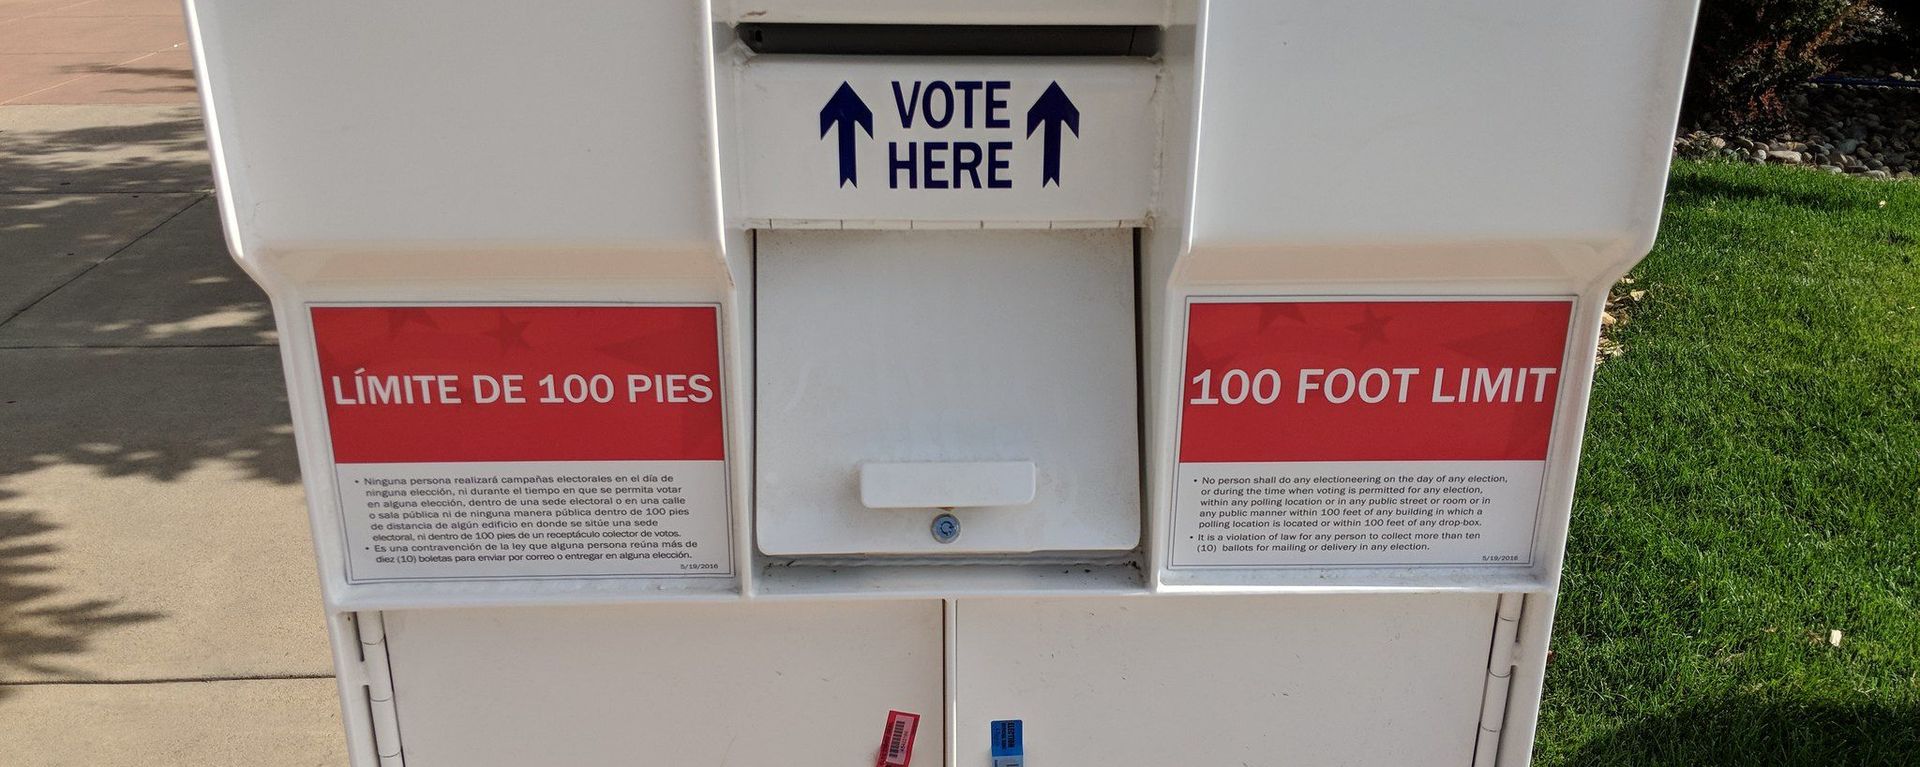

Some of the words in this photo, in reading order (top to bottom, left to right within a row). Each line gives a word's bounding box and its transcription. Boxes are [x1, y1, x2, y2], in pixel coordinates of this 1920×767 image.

[891, 80, 1011, 129] VOTE
[888, 141, 1013, 189] HERE
[331, 367, 462, 405] LÍMITE
[472, 374, 526, 404] DE
[538, 373, 614, 404] 100
[627, 373, 714, 404] PIES
[1190, 368, 1281, 405] 100
[1297, 367, 1420, 404] FOOT
[1431, 367, 1557, 403] LIMIT
[363, 477, 407, 487] Ninguna
[453, 476, 498, 484] realizará
[500, 475, 554, 484] campañas
[642, 474, 658, 482] día
[660, 474, 673, 482] de
[1202, 476, 1215, 484] No
[1217, 477, 1250, 485] person
[1293, 477, 1311, 485] any
[1312, 475, 1381, 485] electioneering
[1416, 475, 1433, 484] day
[1447, 476, 1465, 484] any
[1467, 475, 1507, 483] election,
[365, 489, 407, 498] ninguna
[409, 487, 455, 496] elección,
[470, 487, 510, 495] durante
[524, 487, 560, 495] tiempo
[578, 487, 597, 495] que
[614, 485, 653, 494] permita
[1213, 487, 1244, 496] during
[1246, 487, 1261, 495] the
[1316, 486, 1345, 495] voting
[1358, 486, 1405, 495] permitted
[1407, 485, 1421, 493] for
[1423, 487, 1440, 495] any
[1442, 486, 1483, 494] election,
[383, 500, 417, 509] alguna
[420, 498, 466, 507] elección,
[504, 498, 517, 506] de
[541, 497, 566, 505] sede
[569, 497, 613, 505] electoral
[662, 496, 685, 504] calle
[1200, 498, 1228, 506] within
[1230, 499, 1248, 507] any
[1250, 498, 1282, 507] polling
[1348, 498, 1366, 506] any
[1368, 497, 1397, 506] public
[377, 511, 399, 519] sala
[402, 510, 439, 519] pública
[454, 510, 467, 518] de
[470, 510, 510, 519] ninguna
[555, 508, 591, 517] pública
[645, 507, 666, 515] 100
[668, 508, 689, 516] pies
[1199, 510, 1216, 519] any
[1218, 509, 1247, 518] public
[1289, 508, 1317, 516] within
[1321, 508, 1340, 516] 100
[1375, 509, 1393, 517] any
[1395, 508, 1433, 517] building
[1447, 507, 1474, 515] which
[386, 522, 432, 530] distancia
[434, 521, 448, 529] de
[450, 520, 478, 530] algún
[481, 520, 518, 528] edificio
[584, 519, 609, 527] sitúe
[1198, 520, 1230, 529] polling
[1283, 519, 1318, 527] located
[1364, 518, 1384, 526] 100
[1386, 518, 1404, 526] feet
[1419, 519, 1436, 527] any
[372, 533, 415, 541] electoral,
[460, 532, 472, 540] de
[475, 531, 494, 539] 100
[496, 532, 516, 540] pies
[517, 531, 530, 539] de
[546, 530, 600, 539] receptáculo
[640, 529, 652, 537] de
[1299, 532, 1312, 540] for
[1314, 534, 1331, 542] any
[1334, 533, 1366, 541] person
[374, 544, 387, 552] Es
[411, 542, 482, 551] contravención
[511, 542, 526, 551] ley
[528, 543, 547, 551] que
[550, 542, 584, 551] alguna
[630, 540, 658, 548] reúna
[661, 540, 683, 548] más
[1196, 544, 1216, 552] (10)
[1256, 543, 1269, 551] for
[1271, 543, 1306, 552] mailing
[1320, 543, 1357, 552] delivery
[1389, 542, 1429, 550] election.
[375, 555, 395, 563] diez
[396, 554, 417, 563] (10)
[418, 554, 453, 562] boletas
[454, 555, 476, 563] para
[508, 554, 523, 562] por
[564, 553, 603, 561] entregar
[619, 551, 650, 560] alguna
